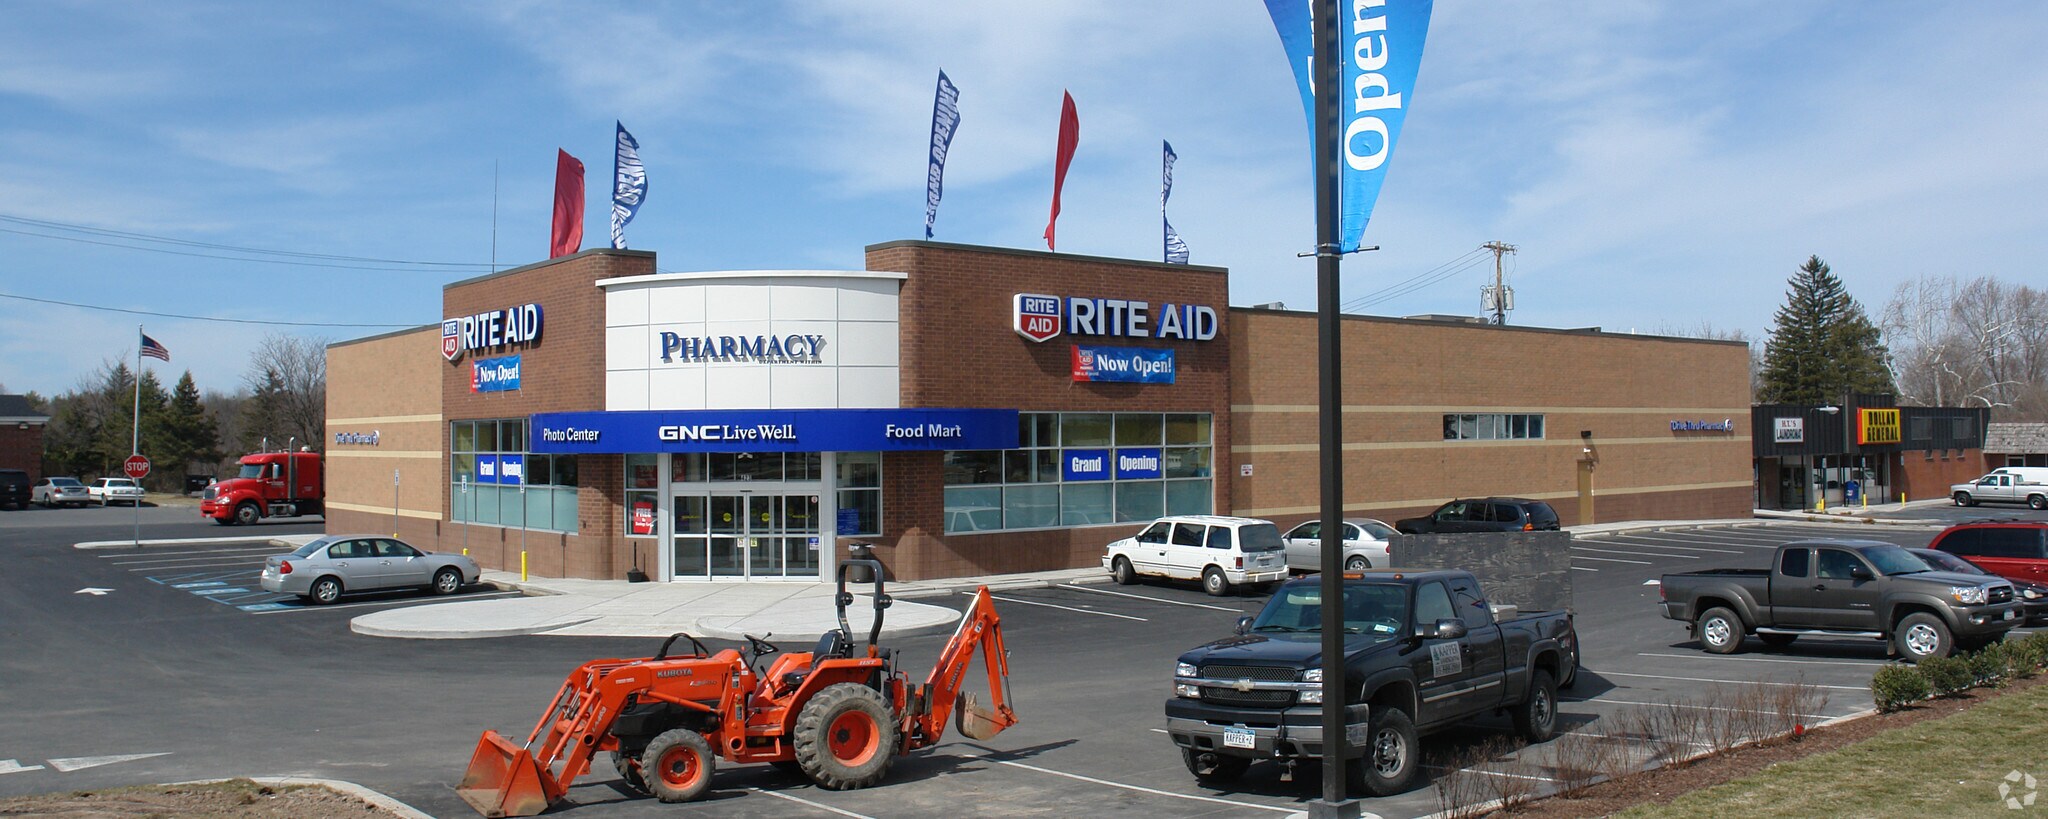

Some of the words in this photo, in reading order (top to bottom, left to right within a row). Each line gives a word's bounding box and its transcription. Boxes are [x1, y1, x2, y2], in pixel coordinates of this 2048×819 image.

[1025, 298, 1055, 314] RITE
[1028, 317, 1053, 333] AID
[1067, 296, 1149, 338] RITE
[1156, 303, 1218, 341] AID
[444, 322, 457, 336] RITE
[463, 310, 502, 350] RITE
[504, 303, 540, 344] AID
[444, 337, 456, 352] AID
[1097, 354, 1129, 372] Now
[1132, 355, 1172, 377] Open!
[480, 366, 497, 383] Now
[497, 362, 519, 385] Open!
[1868, 411, 1896, 425] DOLLAR
[543, 427, 565, 441] Photo
[566, 427, 600, 441] Center
[658, 425, 721, 440] GNC
[722, 425, 757, 440] Live
[885, 423, 924, 438] Food
[928, 423, 962, 438] Mart
[1866, 426, 1899, 441] GENERAL
[126, 461, 148, 472] STOP
[480, 461, 495, 476] Grand
[502, 461, 522, 478] Opening
[1071, 456, 1102, 473] Grand
[1119, 455, 1158, 472] Opening
[635, 508, 652, 518] FREE
[1439, 643, 1459, 657] KAPPER
[657, 668, 693, 678] KUBOTA
